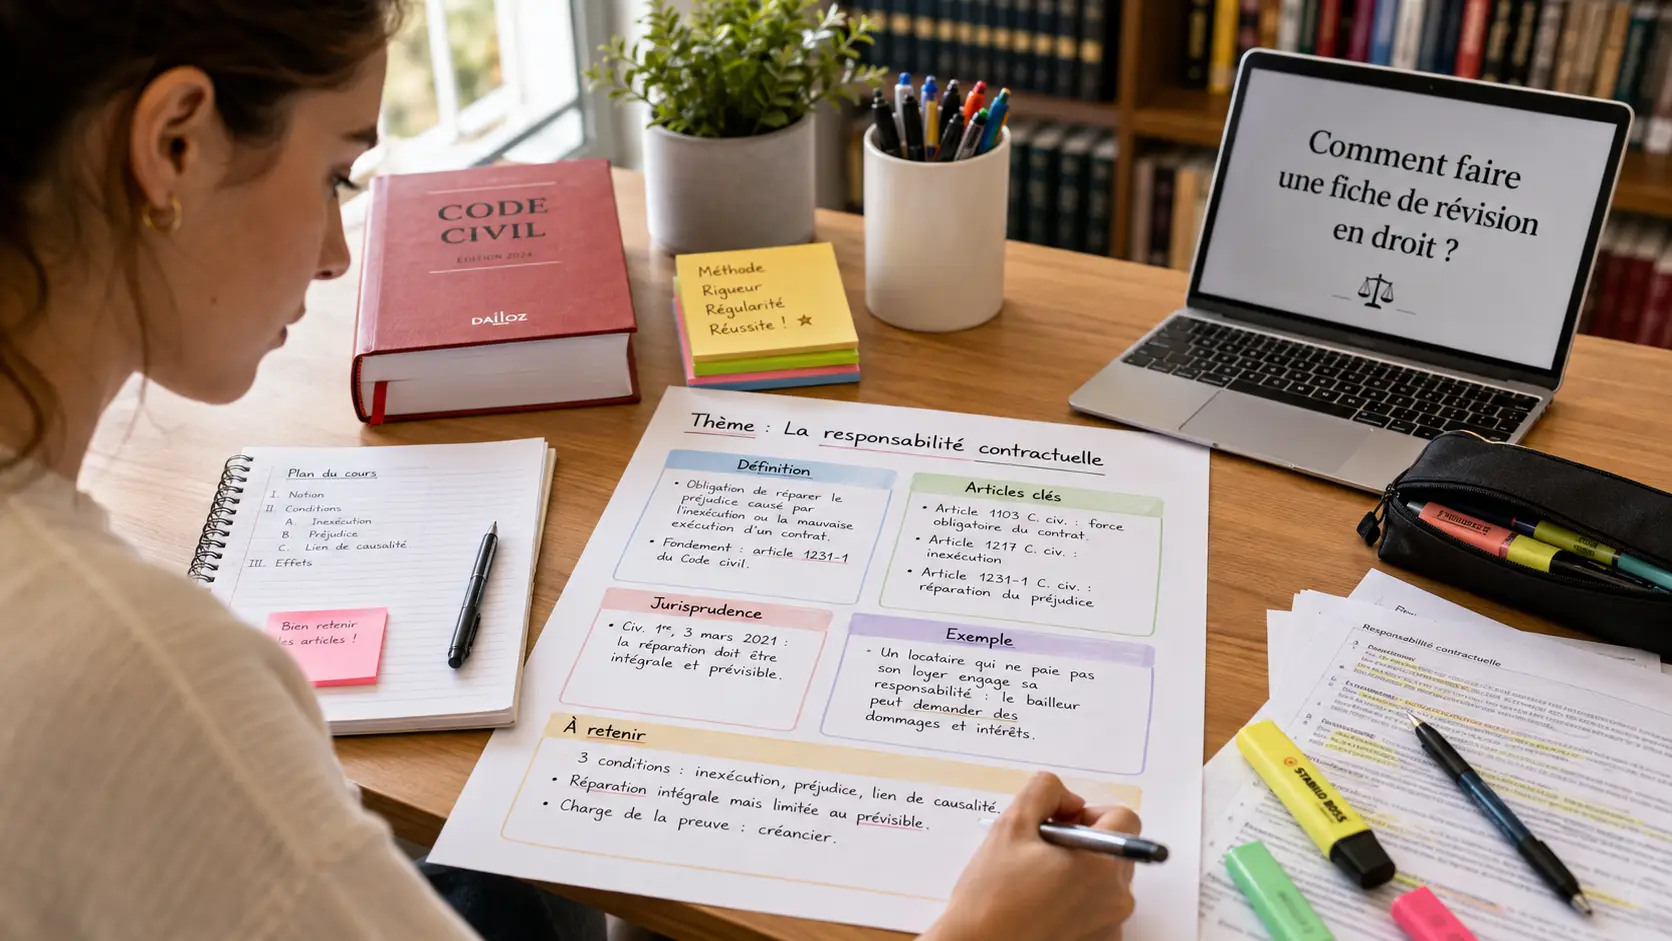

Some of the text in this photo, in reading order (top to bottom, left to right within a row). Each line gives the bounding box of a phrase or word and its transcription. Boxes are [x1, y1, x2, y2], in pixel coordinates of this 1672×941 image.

[1309, 130, 1521, 189] Comment faire
[438, 197, 548, 221] CODE
[1279, 171, 1538, 236] une fiche de révision
[441, 222, 546, 244] CIVIL
[1333, 224, 1459, 262] en droit ?
[699, 262, 765, 277] Méthode
[702, 284, 762, 300] Rigueur
[706, 297, 785, 319] Régularité
[710, 316, 786, 335] Réussite !
[691, 412, 756, 432] Thème
[784, 421, 809, 436] La
[824, 430, 965, 452] responsabilité
[978, 443, 1104, 467] contractuelle
[288, 468, 377, 479] Plan du cours
[737, 459, 810, 476] Définition
[687, 480, 842, 502] Obligation de réparer le
[965, 482, 1061, 502] Articles clés
[285, 505, 342, 513] Conditions
[681, 494, 738, 509] préjudice
[792, 506, 814, 515] par
[312, 517, 371, 525] Inexécution
[777, 514, 787, 524] la
[798, 520, 853, 530] mauvaise
[934, 517, 1089, 541] obligatoire du contrat.
[935, 504, 978, 516] Article
[990, 509, 1019, 519] 1103
[1046, 516, 1066, 525] civ.
[1089, 518, 1124, 531] force
[309, 530, 358, 541] Préjudice
[672, 520, 831, 542] exécution d'un contrat.
[663, 538, 732, 552] Fondement
[753, 547, 793, 557] article
[804, 550, 848, 562] 1231-1
[927, 549, 1002, 564] inexécution
[929, 535, 973, 548] Article
[986, 541, 1016, 551] 1217
[1044, 547, 1065, 556] civ.
[276, 559, 312, 567] Effets
[657, 552, 749, 568] du Code civil.
[921, 567, 966, 580] Article
[980, 573, 1027, 586] 1231-1
[1058, 582, 1079, 591] civ.
[920, 582, 1094, 608] réparation du préjudice
[651, 597, 762, 619] Jurisprudence
[282, 620, 357, 630] Bien retenir
[622, 621, 645, 633] Civ.
[684, 627, 692, 637] 3
[701, 633, 732, 641] mars
[743, 634, 776, 645] 2021
[301, 636, 345, 645] articles
[353, 633, 357, 643] !
[618, 636, 777, 662] la réparation doit être
[946, 628, 1014, 649] Exemple
[1362, 623, 1434, 649] Responsabilité
[1436, 646, 1501, 667] contractuelle
[611, 653, 781, 680] intégrale et prévisible.
[881, 647, 898, 658] Un
[909, 649, 965, 665] locataire
[975, 660, 995, 672] qui
[1032, 666, 1060, 677] paie
[1071, 671, 1094, 682] pas
[878, 665, 1038, 689] son loyer engage sa
[875, 682, 971, 698] responsabilité
[1003, 691, 1014, 703] le
[1027, 694, 1080, 709] bailleur
[870, 697, 1018, 722] peut demander des
[563, 716, 646, 742] À retenir
[866, 710, 1035, 740] dommages et intérêts.
[578, 752, 588, 763] 3
[598, 757, 670, 773] conditions
[696, 766, 785, 789] inexécution,
[794, 780, 862, 799] préjudice,
[873, 786, 896, 800] lien
[906, 791, 923, 804] de
[934, 797, 1001, 816] causalité.
[1294, 767, 1347, 822] STABILO BOSS
[570, 774, 929, 829] Réparation intégrale mais limitée au prévisible.
[560, 799, 612, 821] Charge
[624, 807, 642, 820] de
[654, 809, 666, 822] la
[678, 818, 729, 830] preuve
[759, 825, 836, 843] créancier.
